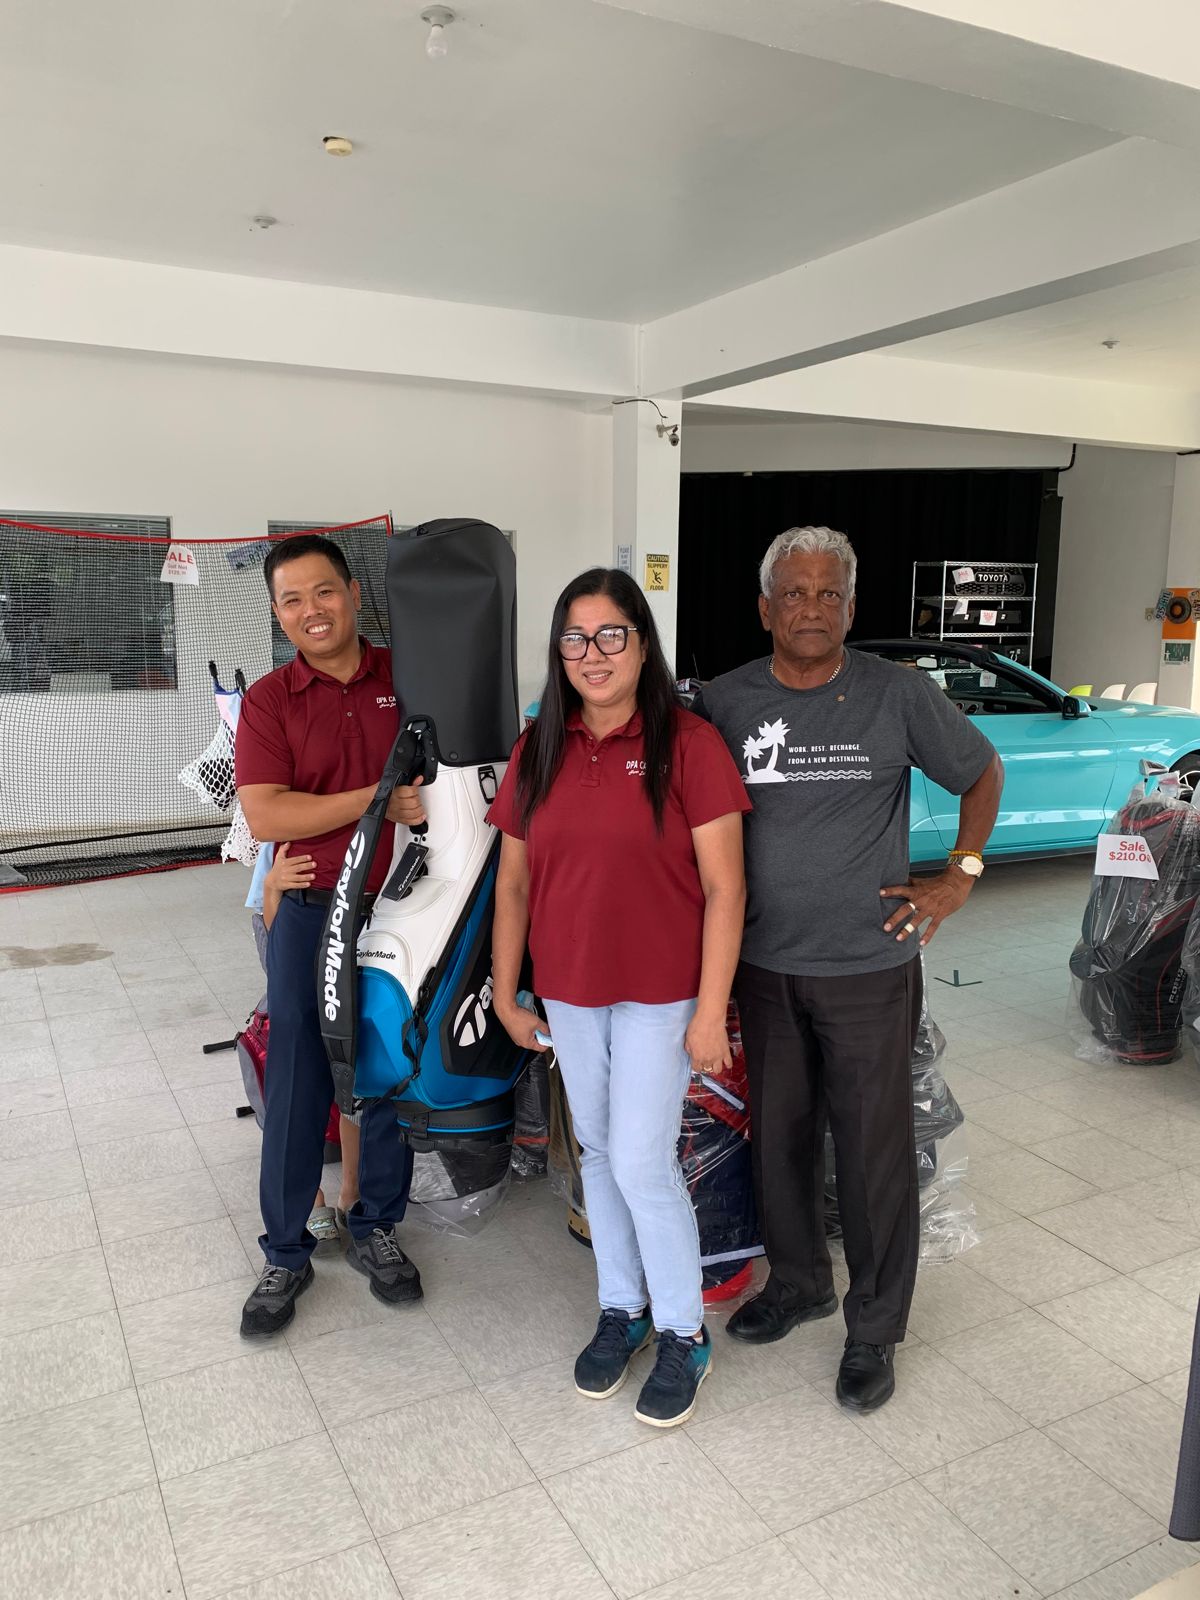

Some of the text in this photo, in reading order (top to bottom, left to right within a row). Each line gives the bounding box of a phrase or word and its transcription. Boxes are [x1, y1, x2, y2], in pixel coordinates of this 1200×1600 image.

[166, 551, 194, 565] ALE
[978, 574, 1009, 582] TOYOTA
[829, 743, 862, 751] RECHARGE.
[787, 757, 806, 765] FROM
[829, 755, 870, 763] DESTINATION
[1119, 840, 1146, 852] Sale
[1109, 851, 1152, 863] $210.00
[324, 830, 365, 1022] TaylorMade
[357, 948, 396, 960] aylorMade
